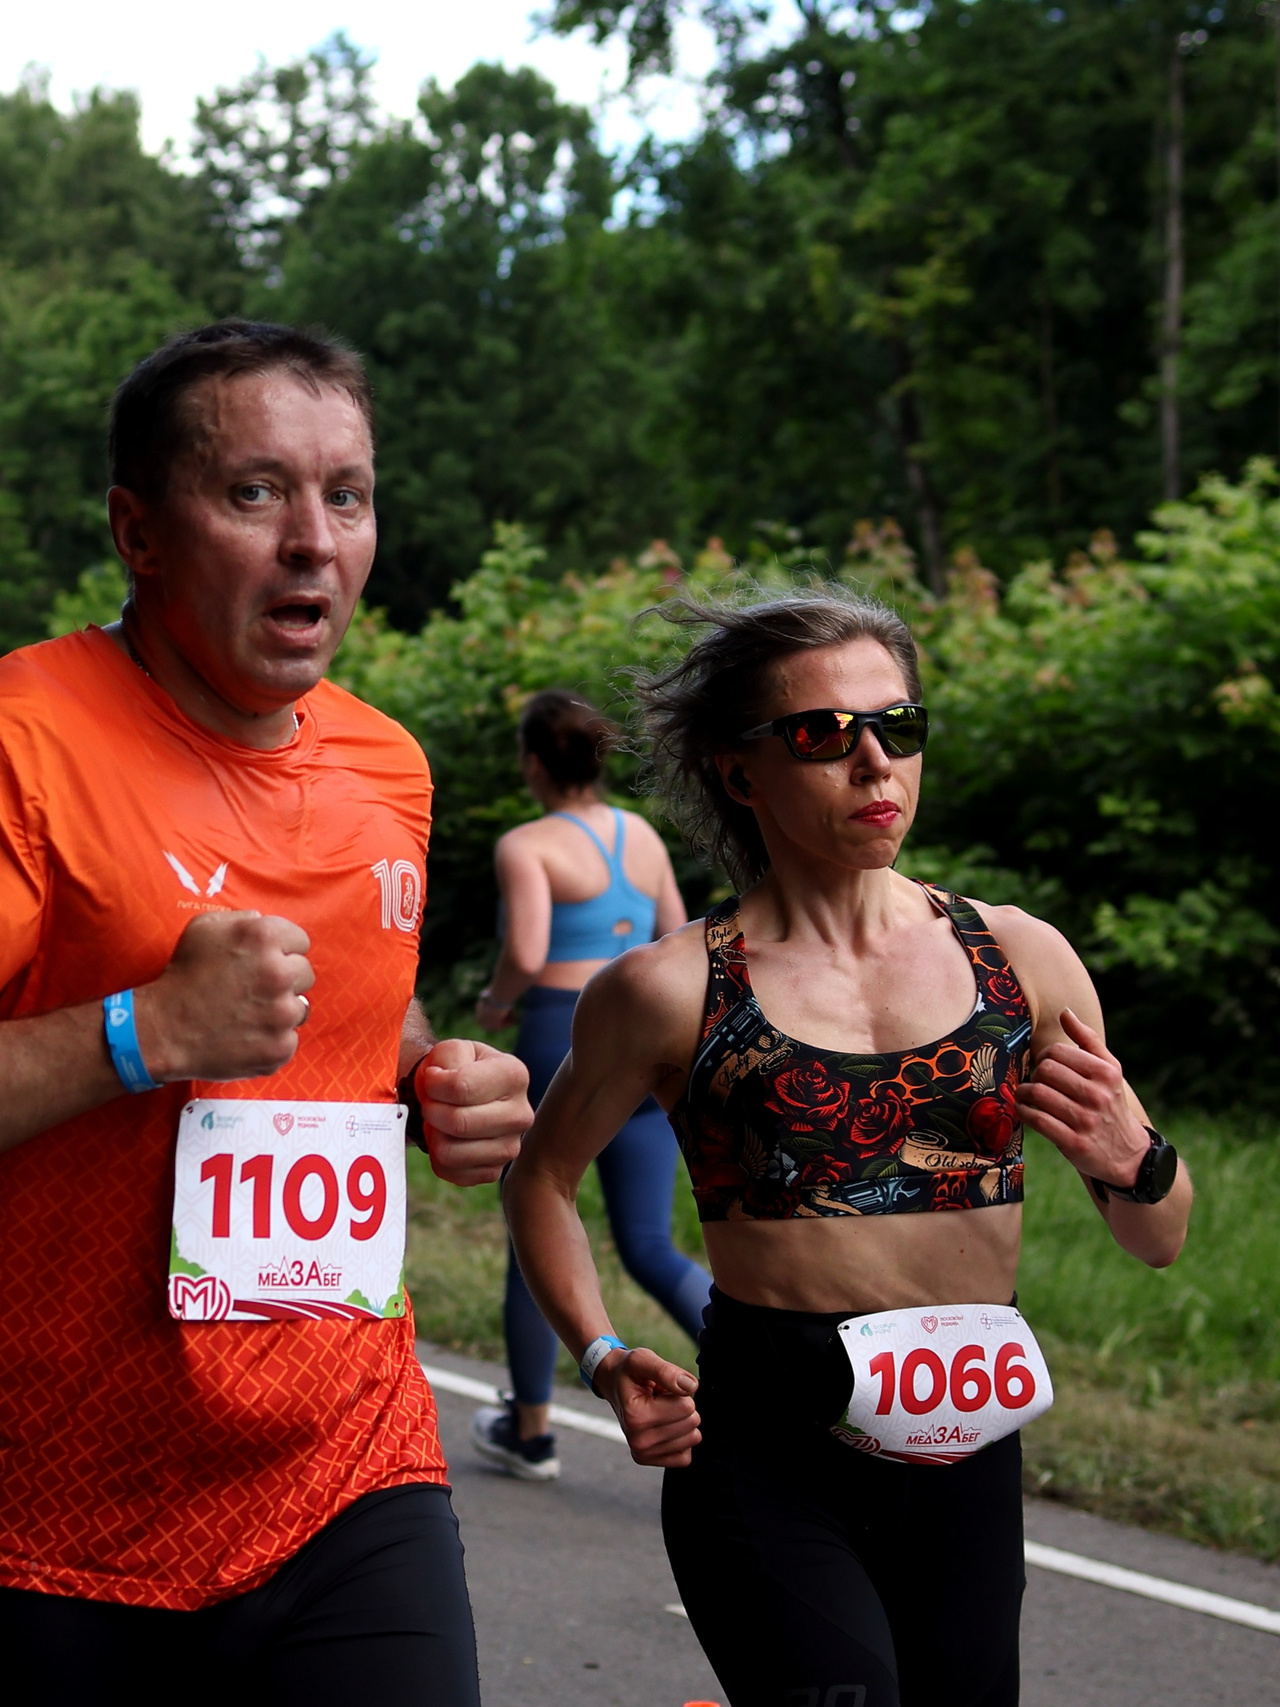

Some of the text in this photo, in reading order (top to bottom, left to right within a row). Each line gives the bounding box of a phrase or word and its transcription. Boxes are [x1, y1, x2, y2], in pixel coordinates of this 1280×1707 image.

[369, 858, 421, 932] 10
[708, 926, 732, 945] Style
[200, 1153, 387, 1241] 1109
[925, 1153, 957, 1168] Old
[869, 1342, 1036, 1416] 1066
